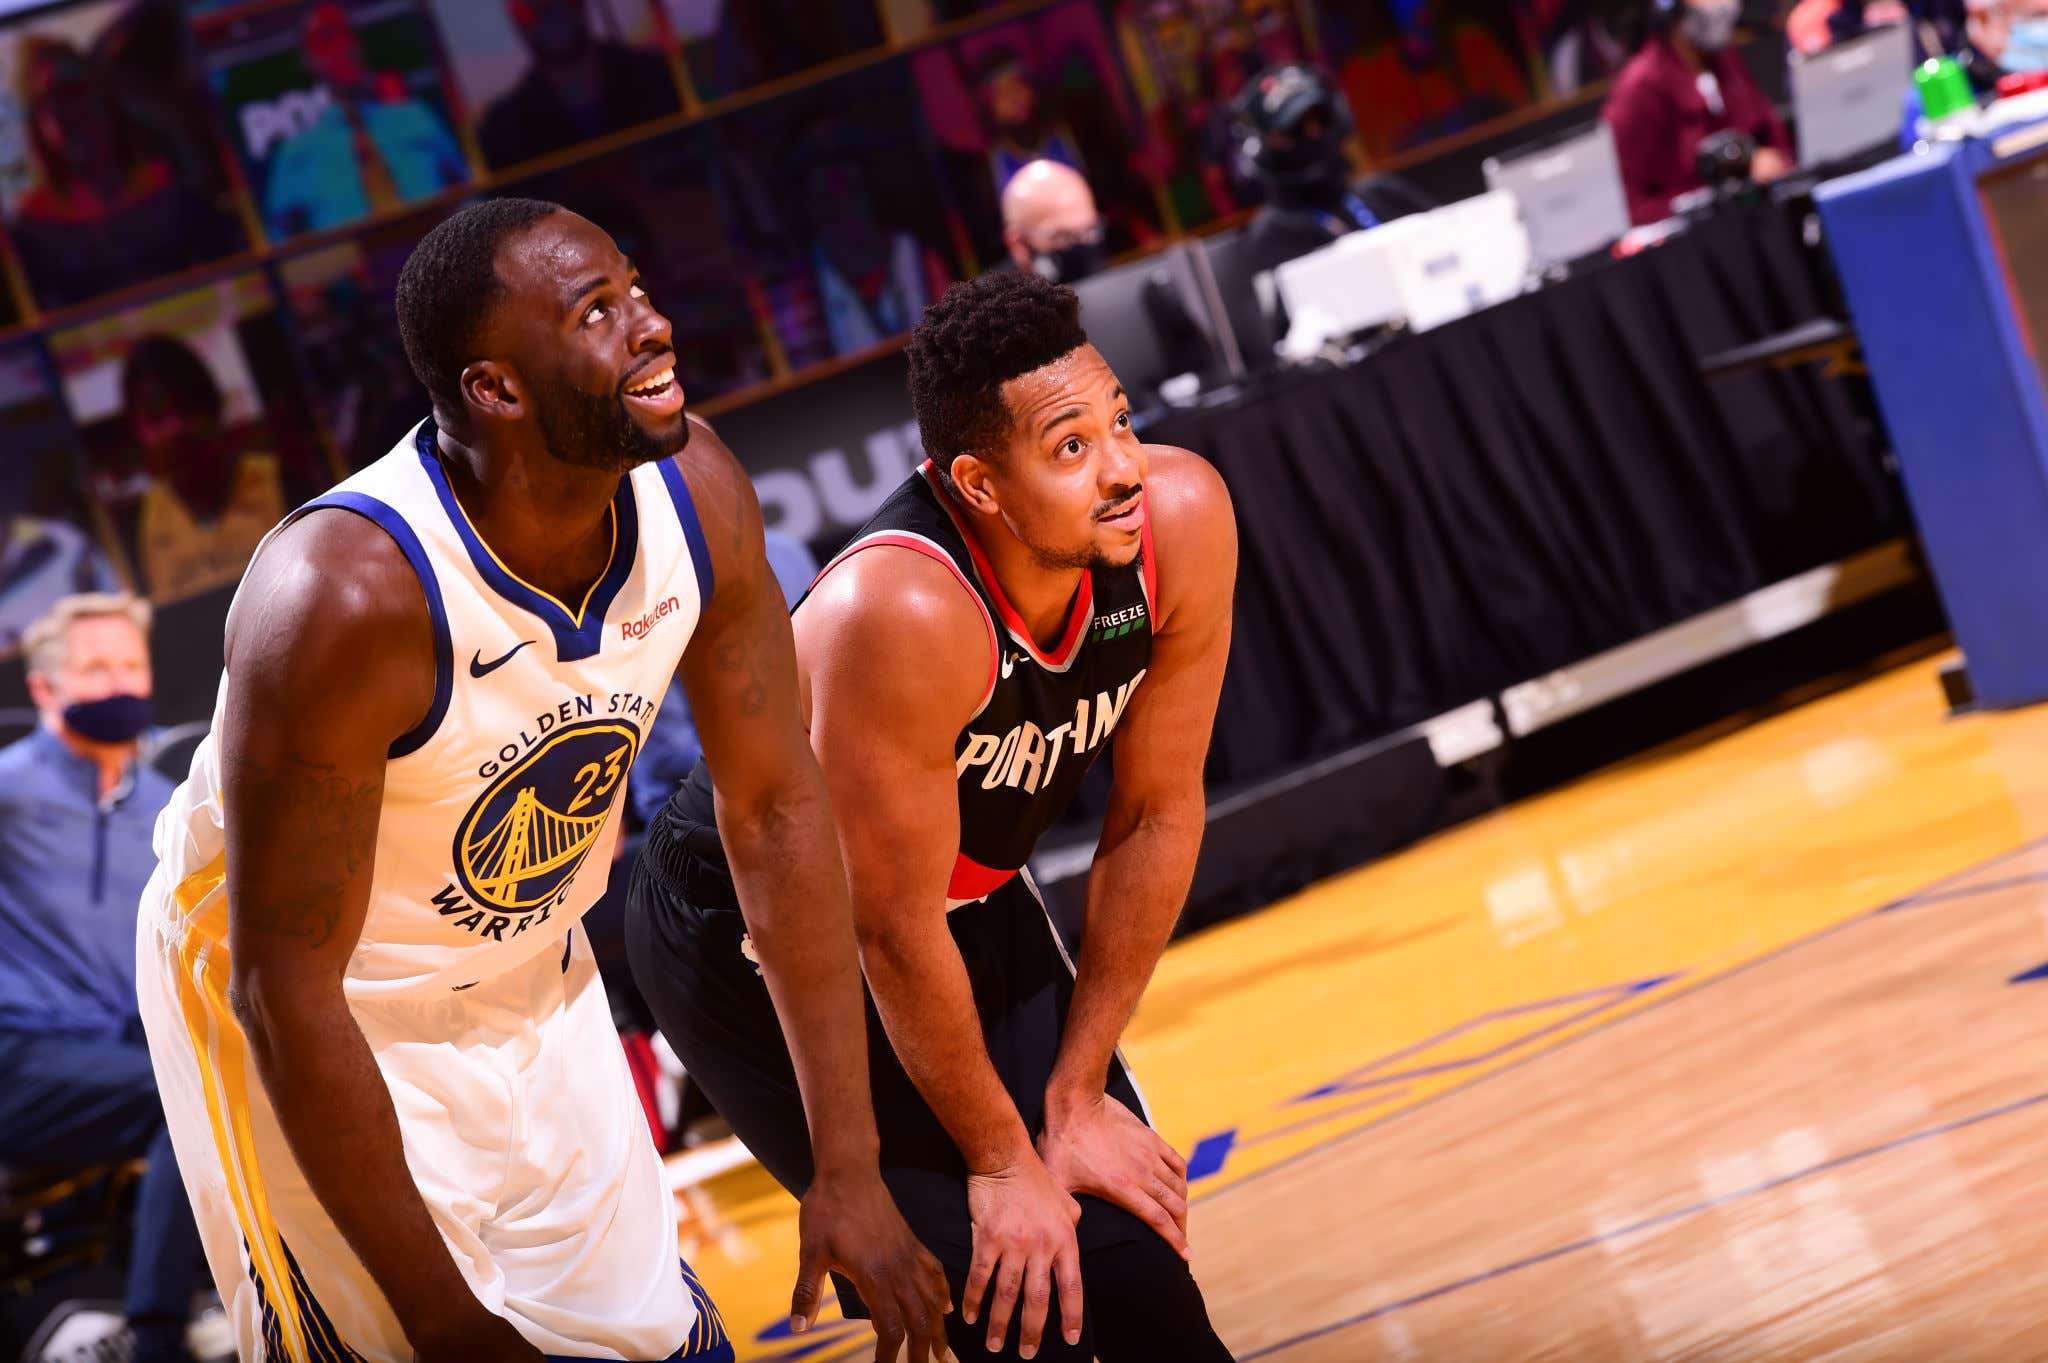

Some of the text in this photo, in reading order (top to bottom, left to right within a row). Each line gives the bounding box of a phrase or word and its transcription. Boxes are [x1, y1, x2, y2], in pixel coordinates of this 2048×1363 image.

[621, 596, 680, 641] Rakuten
[1094, 604, 1146, 630] FREEZE
[478, 693, 655, 778] GOLDEN STAT
[567, 743, 629, 815] 23
